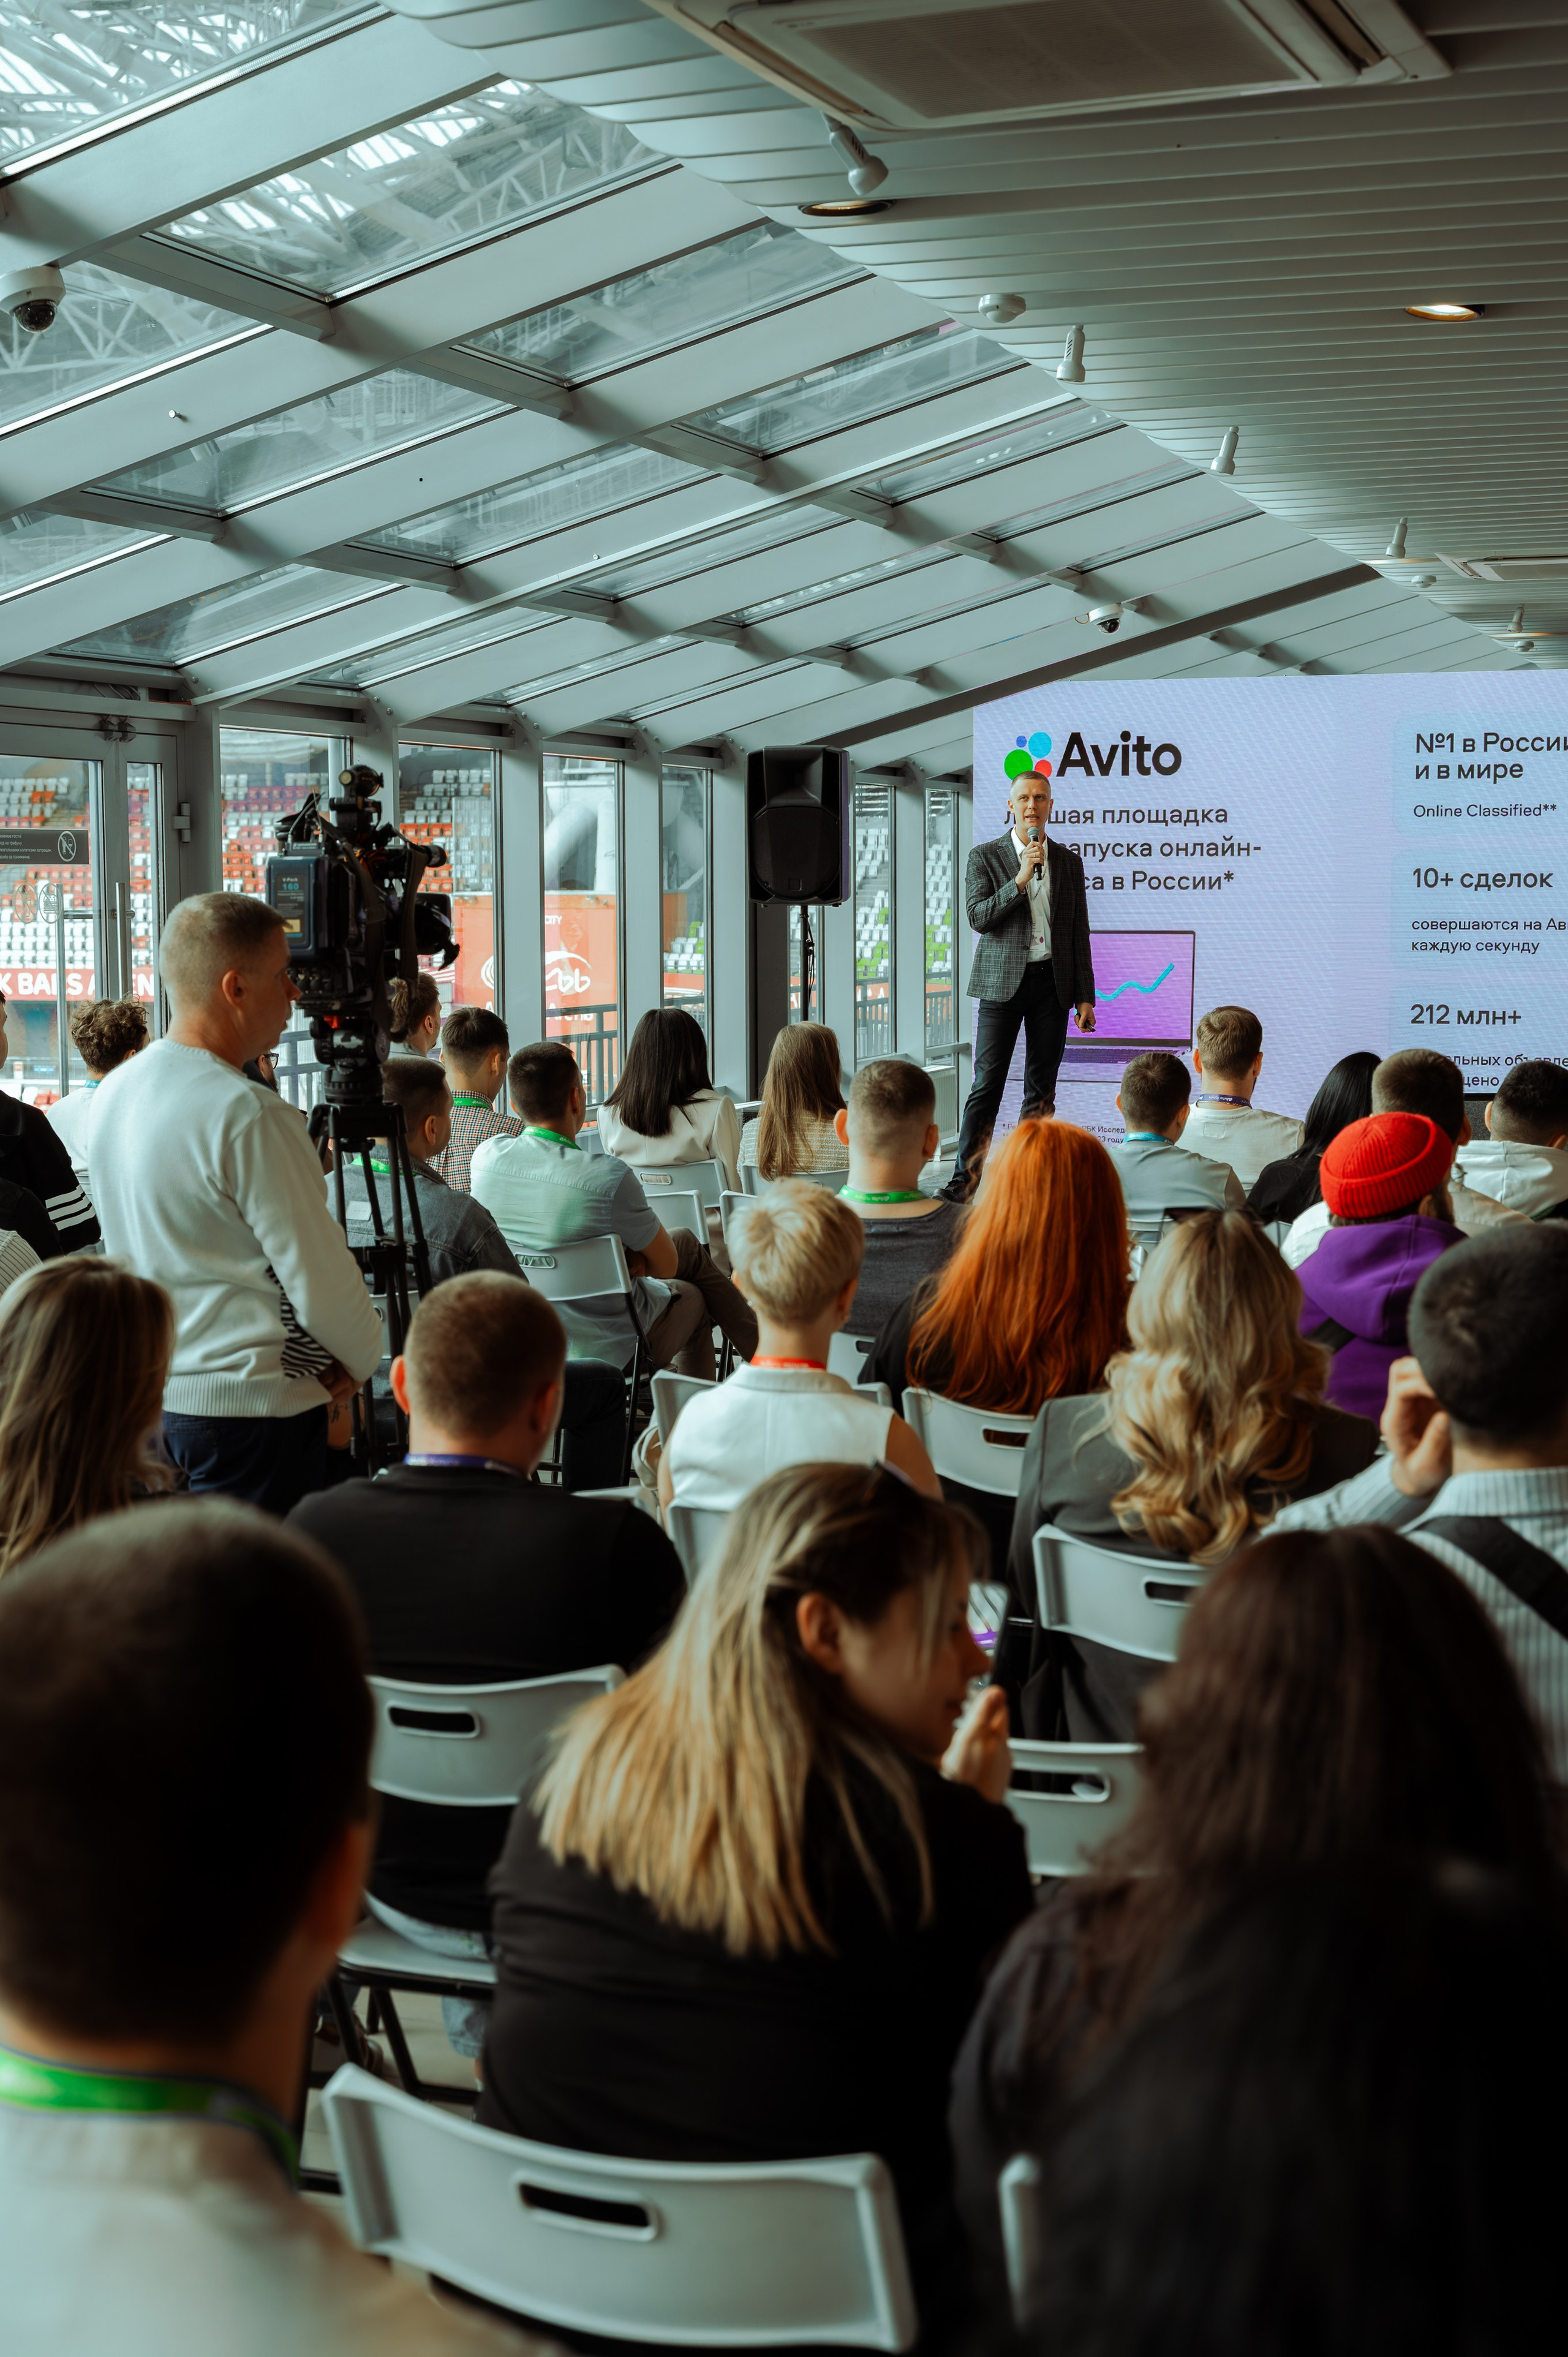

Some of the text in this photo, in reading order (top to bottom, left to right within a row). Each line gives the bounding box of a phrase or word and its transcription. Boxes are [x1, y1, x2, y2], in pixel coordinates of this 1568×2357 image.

[1415, 733, 1455, 753] №1
[1463, 738, 1476, 752] в
[1056, 731, 1182, 777] Avito
[1415, 763, 1523, 784] и в мире
[1005, 808, 1228, 826] лшая площадка
[1413, 805, 1462, 817] Online
[1058, 835, 1261, 862] апуска онлайн-
[1112, 876, 1125, 890] в
[1413, 867, 1553, 891] 10+ сделок
[1411, 918, 1568, 933] совершаются на Ав
[1411, 941, 1540, 954] каждую секунду
[1411, 1004, 1521, 1025] 212 млн+
